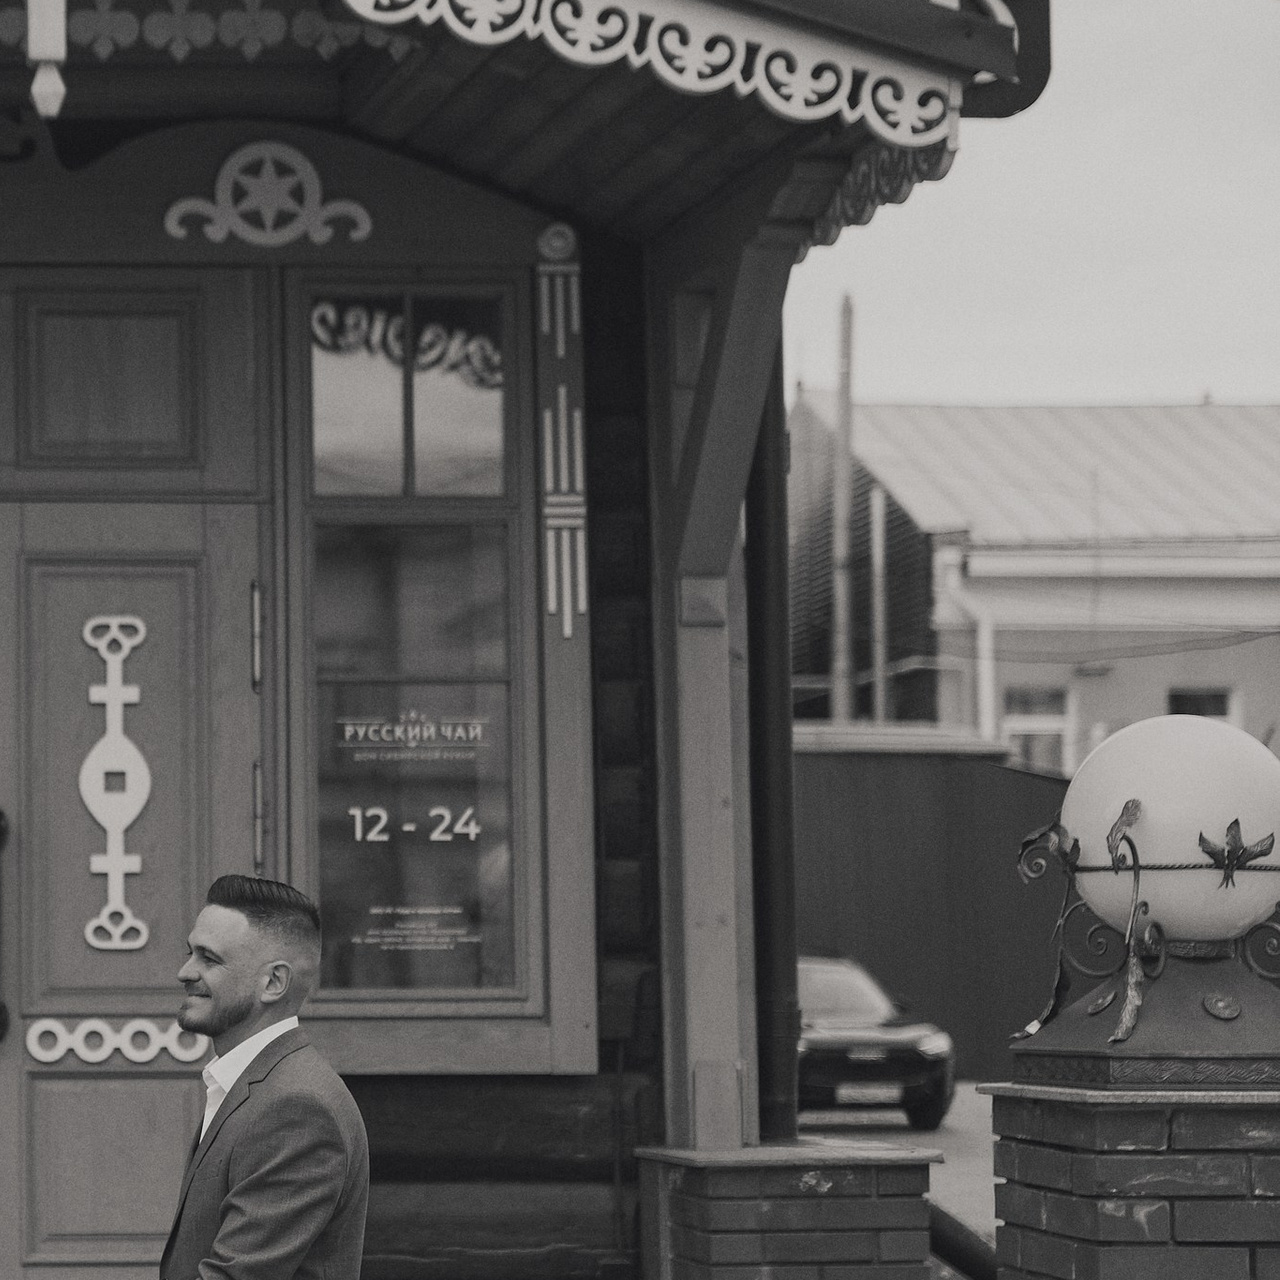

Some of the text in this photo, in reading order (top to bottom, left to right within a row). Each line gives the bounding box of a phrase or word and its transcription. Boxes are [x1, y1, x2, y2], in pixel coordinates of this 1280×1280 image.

[344, 723, 482, 742] РУССКИЙ ЧАЙ
[348, 806, 390, 842] 12
[428, 805, 482, 842] 24
